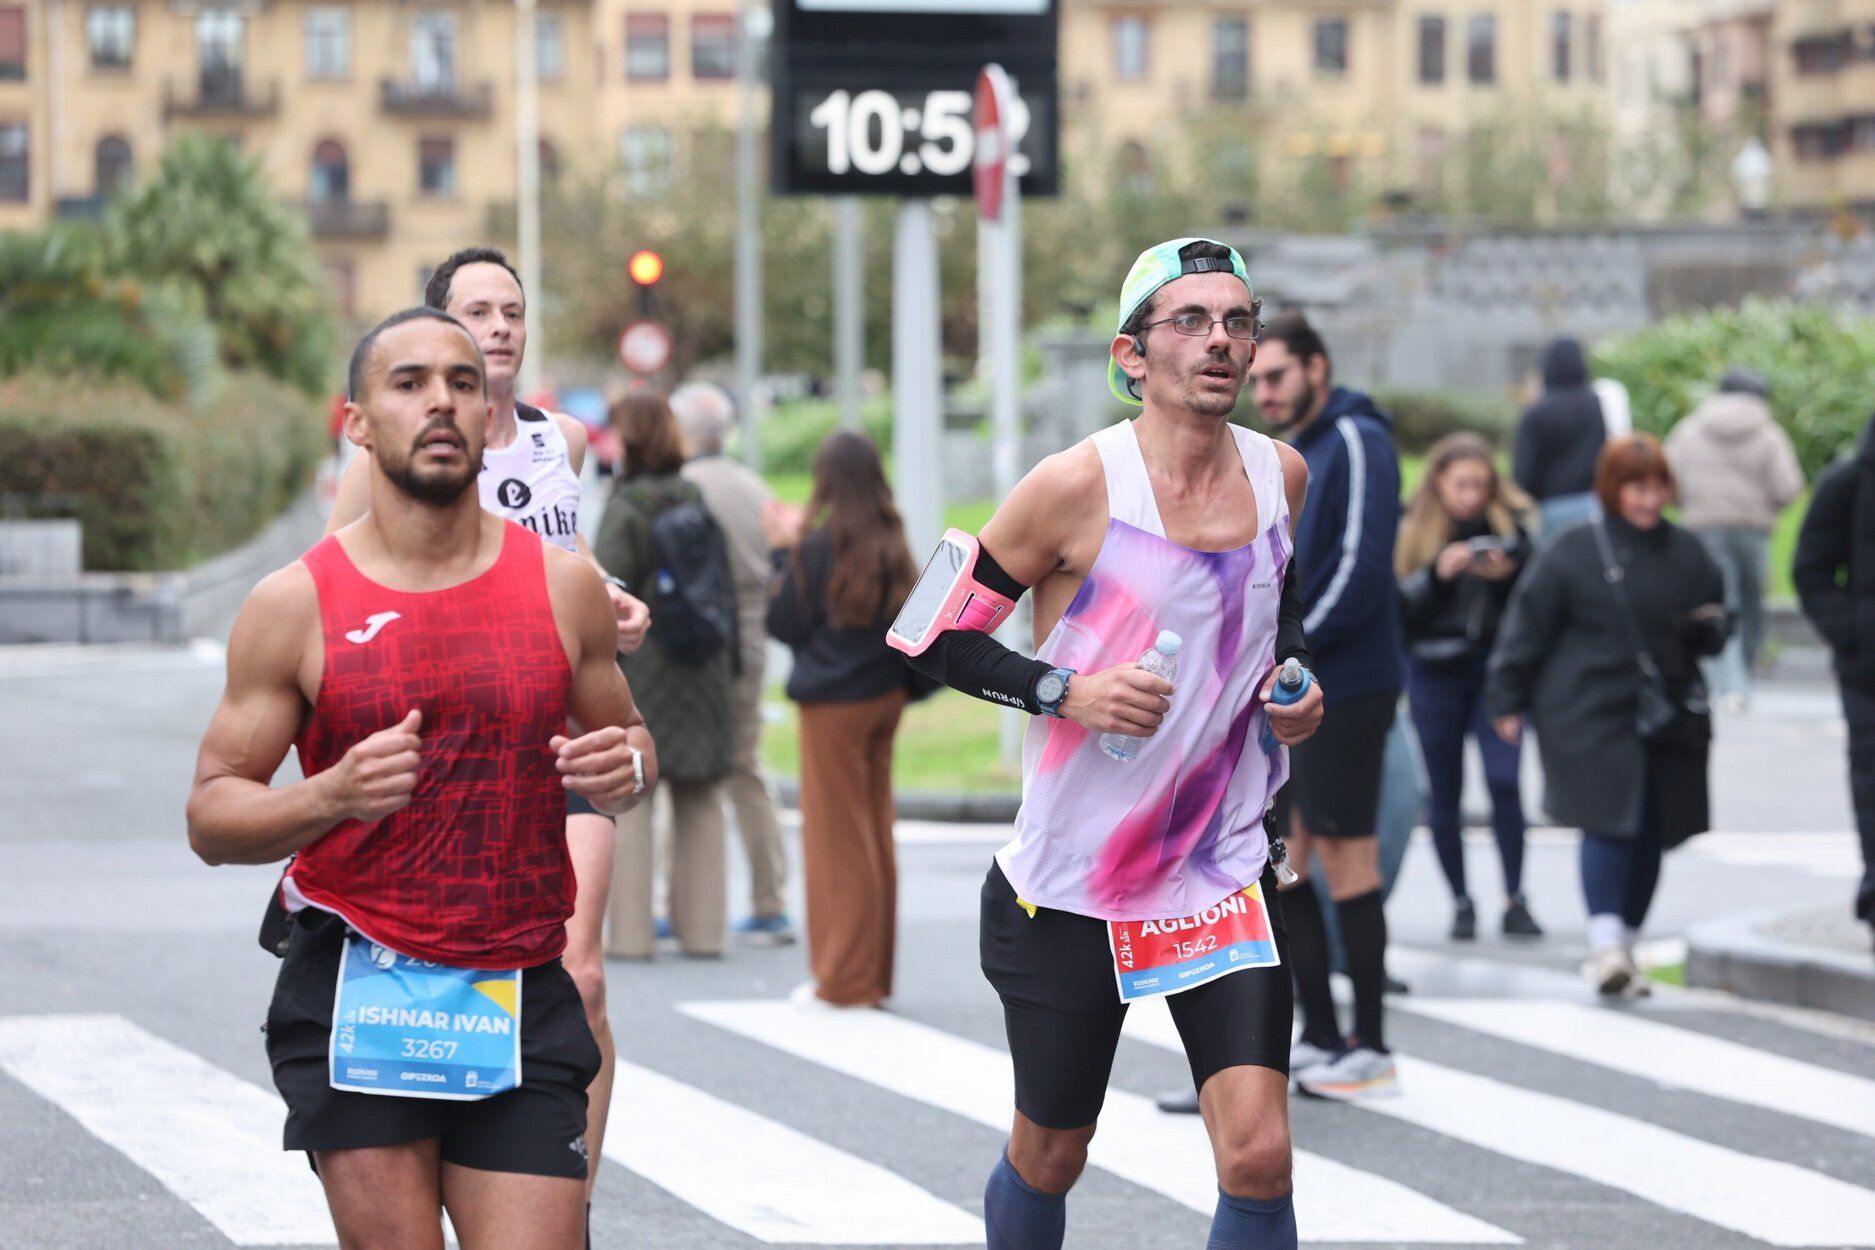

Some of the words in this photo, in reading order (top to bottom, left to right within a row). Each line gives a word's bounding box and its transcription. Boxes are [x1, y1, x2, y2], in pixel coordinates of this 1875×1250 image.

[1140, 896, 1247, 937] AGLIONI
[1119, 944, 1133, 968] 42k
[1173, 935, 1218, 959] 1542
[358, 1005, 449, 1030] ISHNAR
[454, 1014, 511, 1035] IVAN
[339, 1025, 357, 1053] 42k
[401, 1038, 458, 1059] 3267
